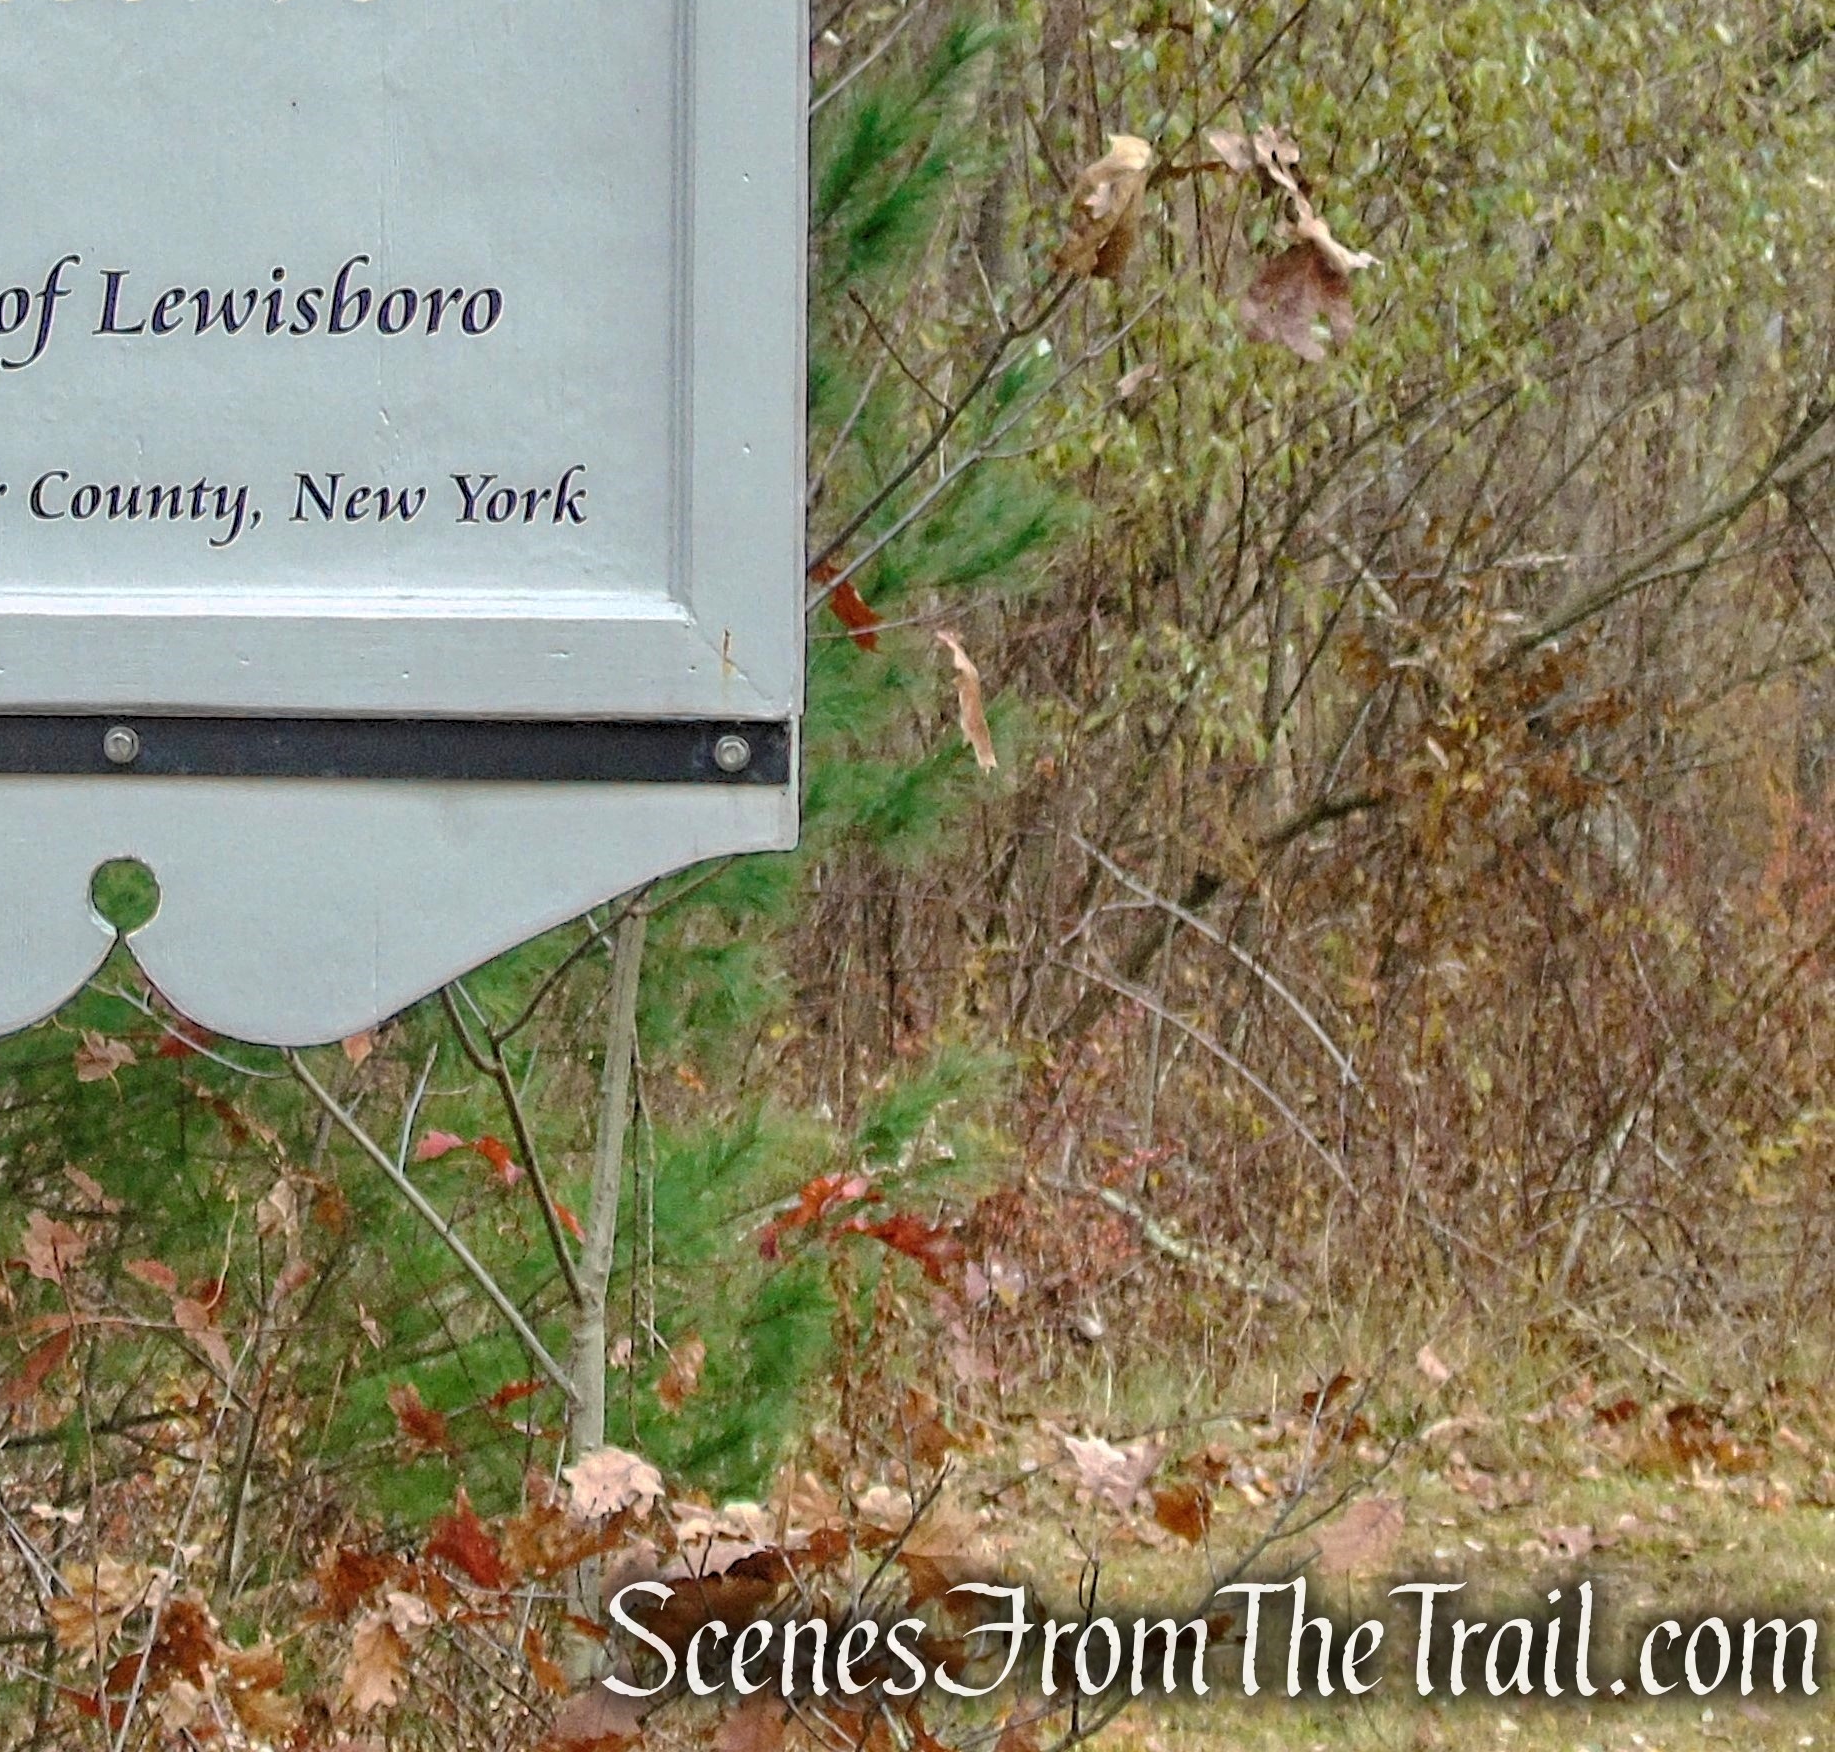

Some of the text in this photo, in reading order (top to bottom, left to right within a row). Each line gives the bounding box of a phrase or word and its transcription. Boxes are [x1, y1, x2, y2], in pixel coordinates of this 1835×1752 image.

[91, 253, 503, 337] Lewisboro
[28, 469, 262, 548] County,
[288, 471, 428, 523] New
[448, 463, 588, 525] York
